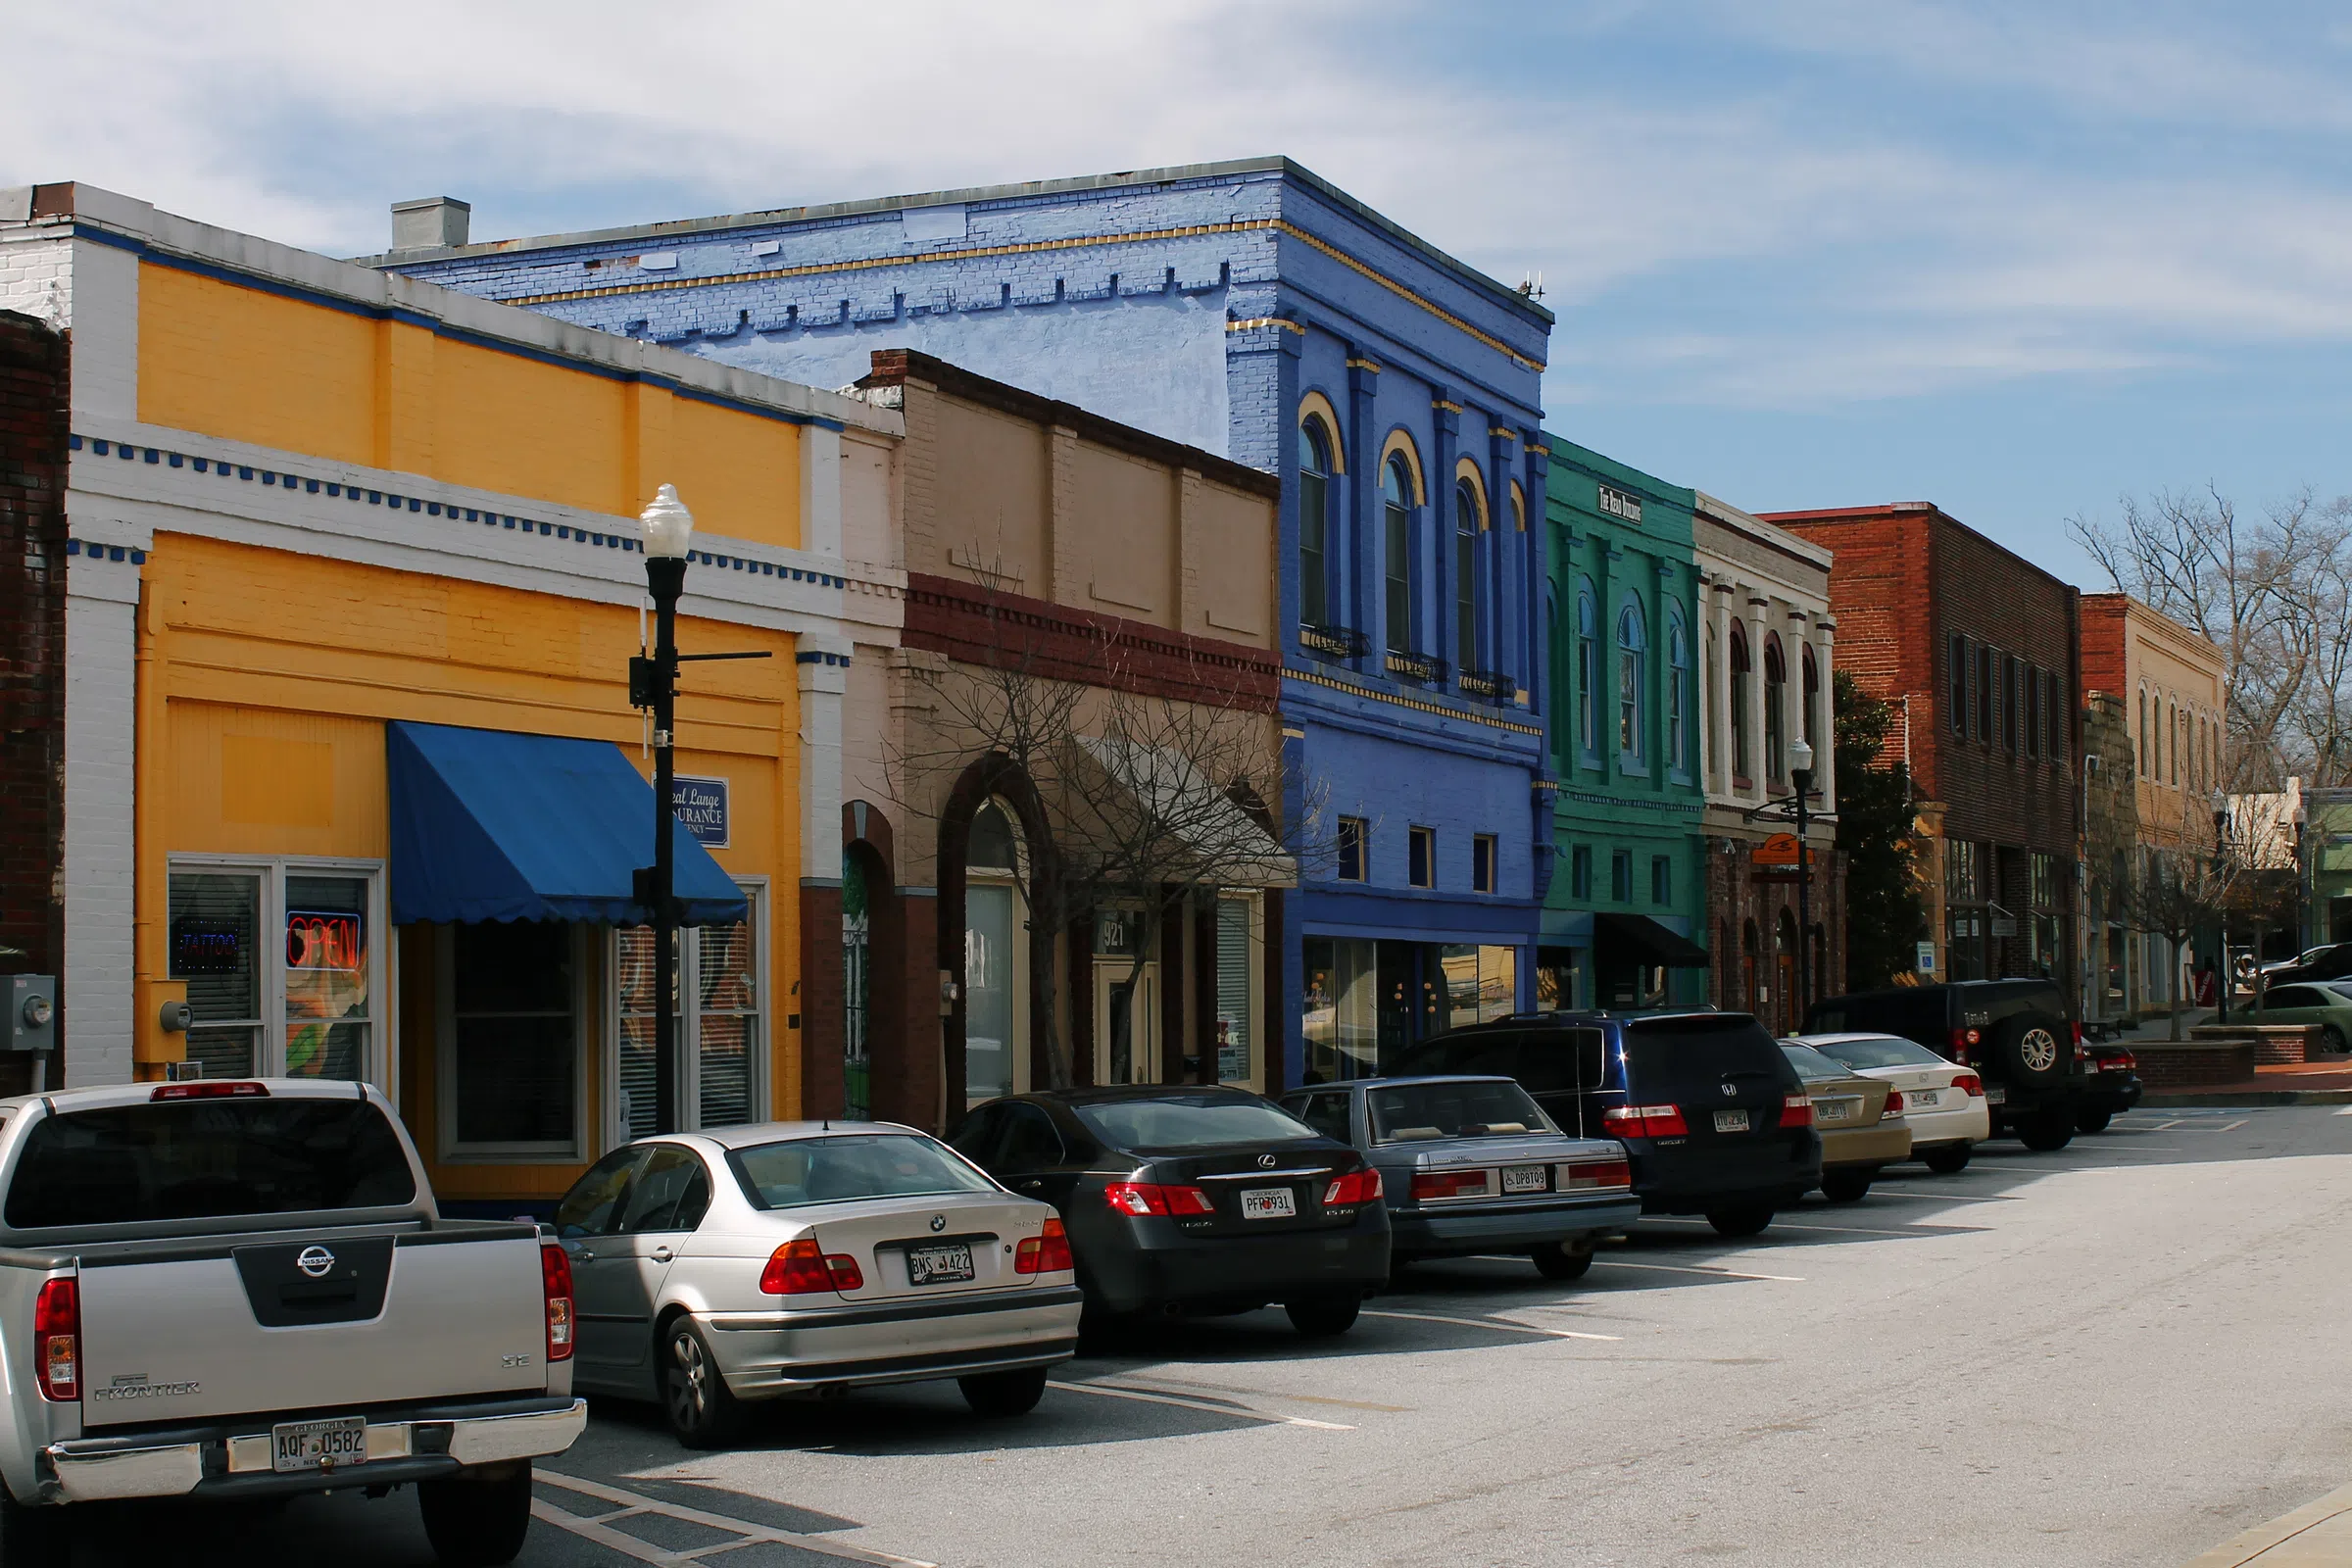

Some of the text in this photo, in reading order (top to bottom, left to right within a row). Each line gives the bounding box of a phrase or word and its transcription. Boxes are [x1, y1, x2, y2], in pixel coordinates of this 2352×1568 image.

[672, 788, 720, 809] eal Lange
[287, 917, 357, 966] OPEN
[1104, 921, 1123, 947] 921
[183, 934, 235, 956] TATTOO
[1515, 1171, 1545, 1185] DP8TQ9
[911, 1256, 934, 1275] BNS
[502, 1352, 530, 1368] SE
[95, 1380, 201, 1400] FRONTIER
[295, 1421, 346, 1432] GEORGIA
[278, 1429, 364, 1459] AQF 0582
